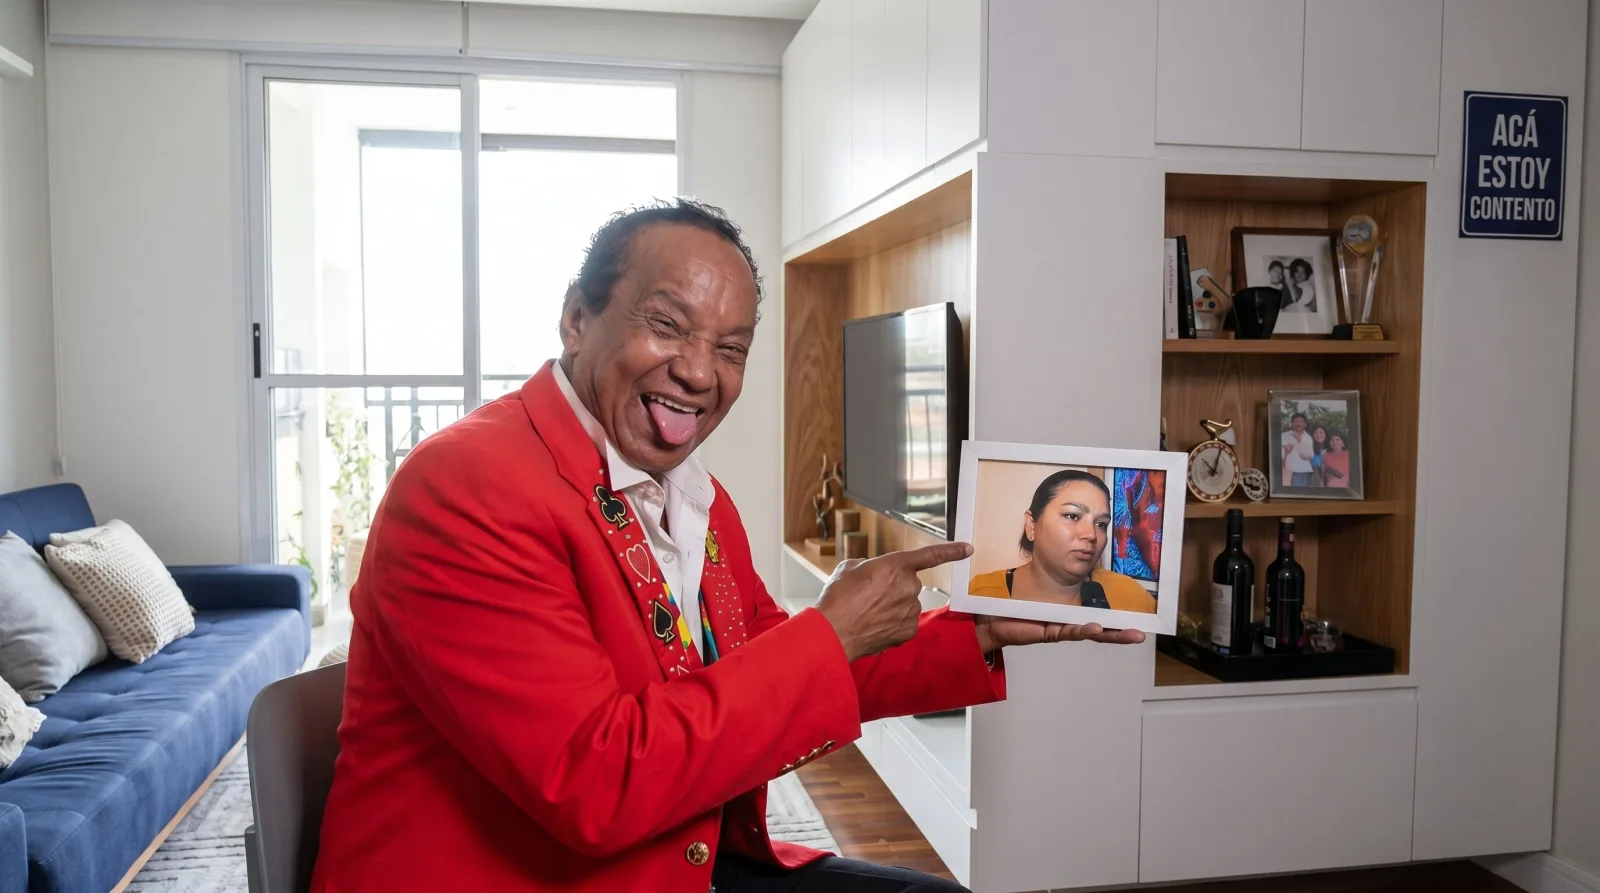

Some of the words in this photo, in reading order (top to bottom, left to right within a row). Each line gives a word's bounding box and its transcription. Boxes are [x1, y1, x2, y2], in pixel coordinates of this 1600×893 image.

[1492, 108, 1539, 147] ACÁ
[1478, 154, 1551, 190] ESTOY
[1470, 195, 1556, 222] CONTENTO
